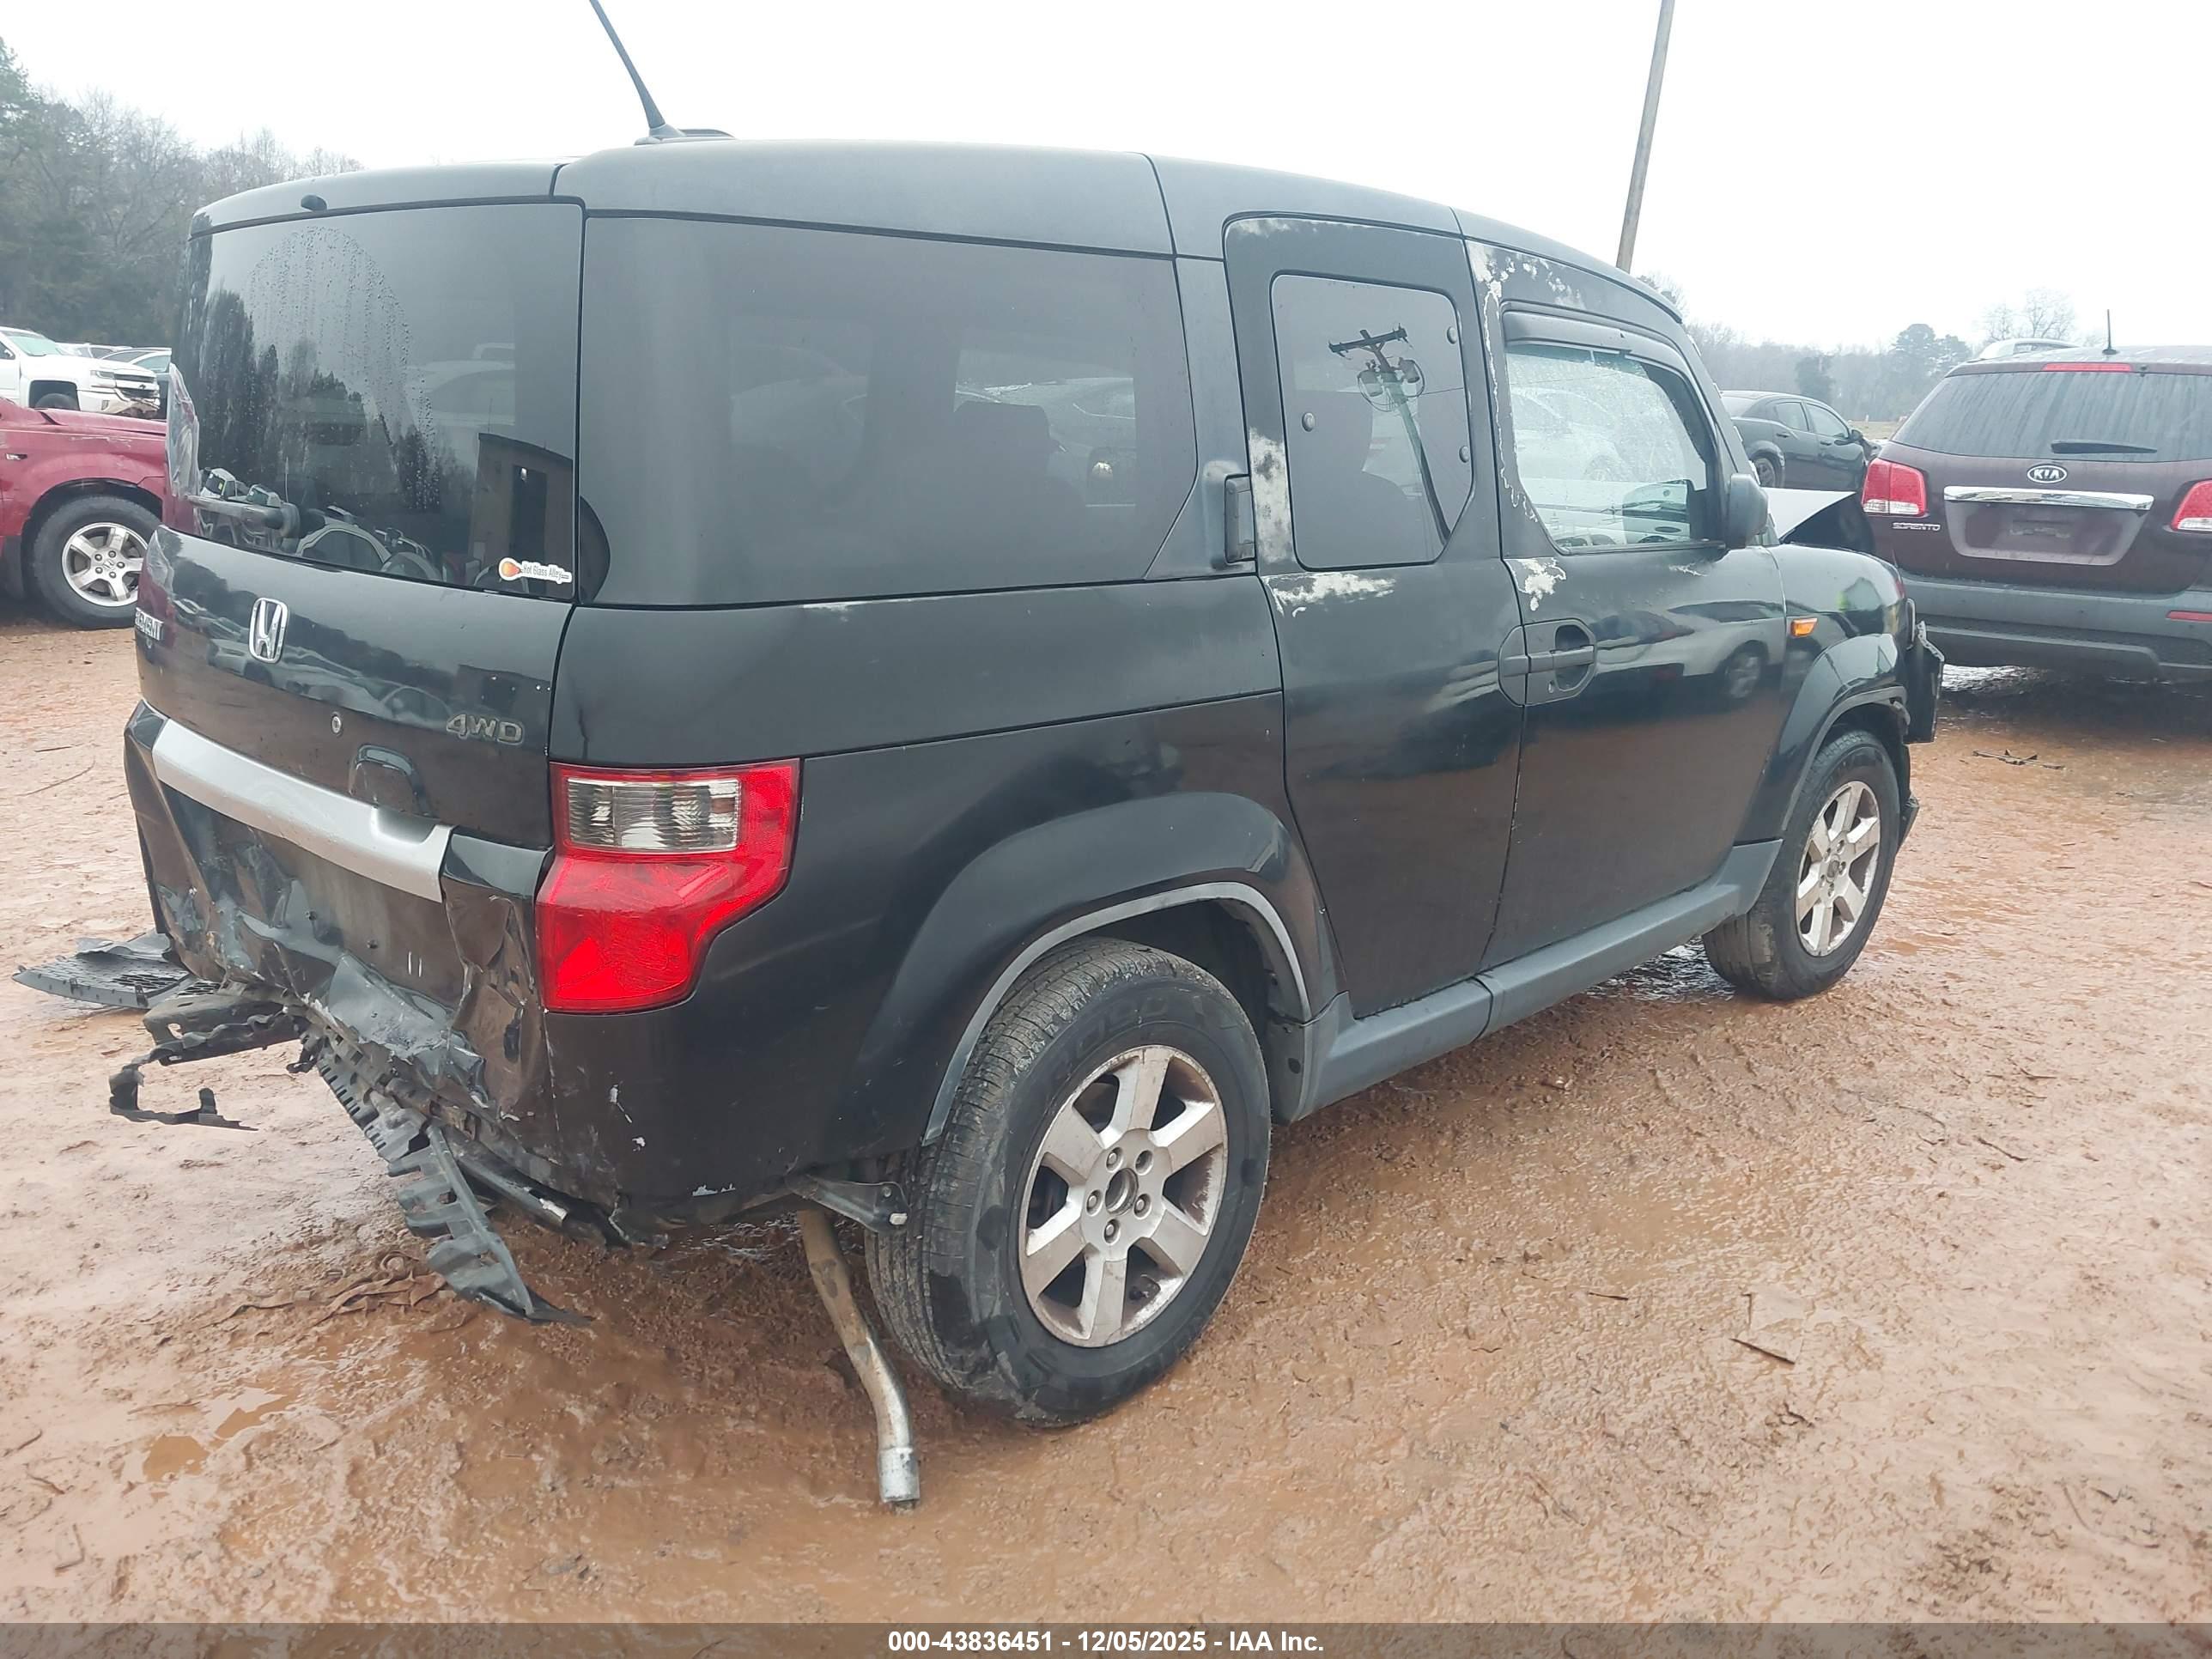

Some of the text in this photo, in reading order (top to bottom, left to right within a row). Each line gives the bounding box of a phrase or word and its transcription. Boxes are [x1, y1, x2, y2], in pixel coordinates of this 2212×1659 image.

[2033, 469, 2060, 479] KIA
[1892, 522, 1941, 532] SORENTO
[522, 563, 532, 574] Hot
[446, 714, 523, 745] 4WD
